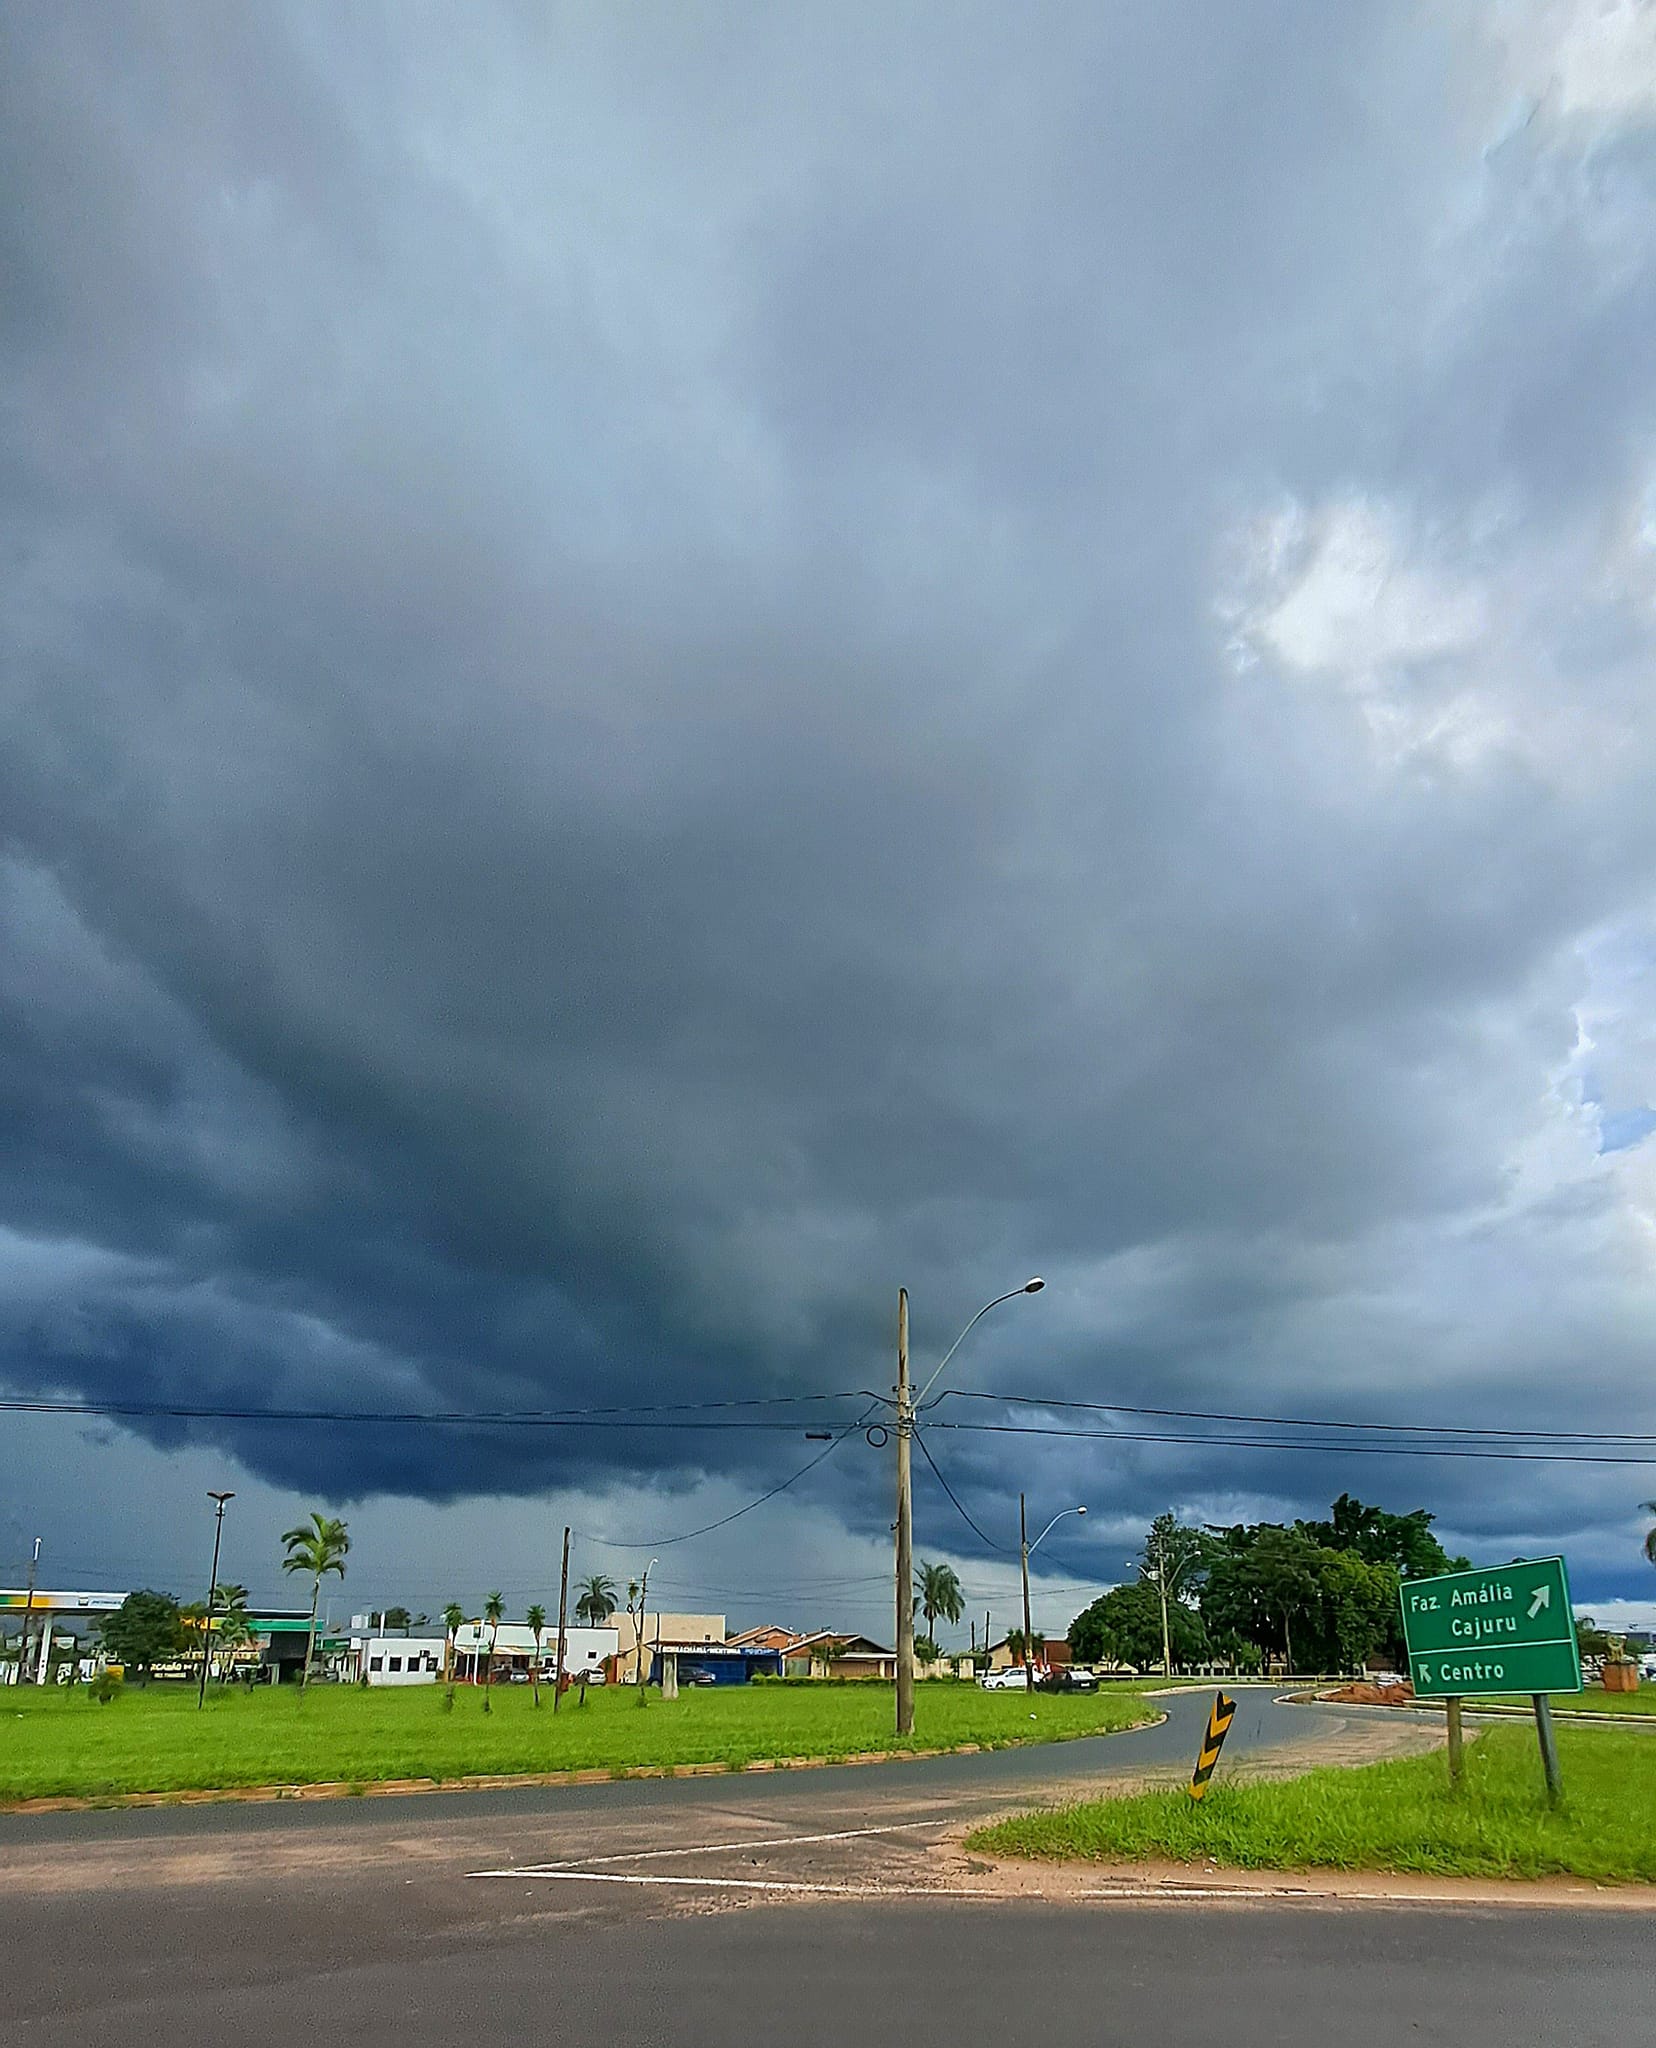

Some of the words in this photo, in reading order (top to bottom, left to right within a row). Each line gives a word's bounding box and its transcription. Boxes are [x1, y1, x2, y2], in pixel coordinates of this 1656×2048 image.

[1411, 1595, 1441, 1613] Faz.
[1451, 1583, 1513, 1607] Amália
[1452, 1617, 1517, 1640] Cajuru
[1440, 1662, 1504, 1681] Centro
